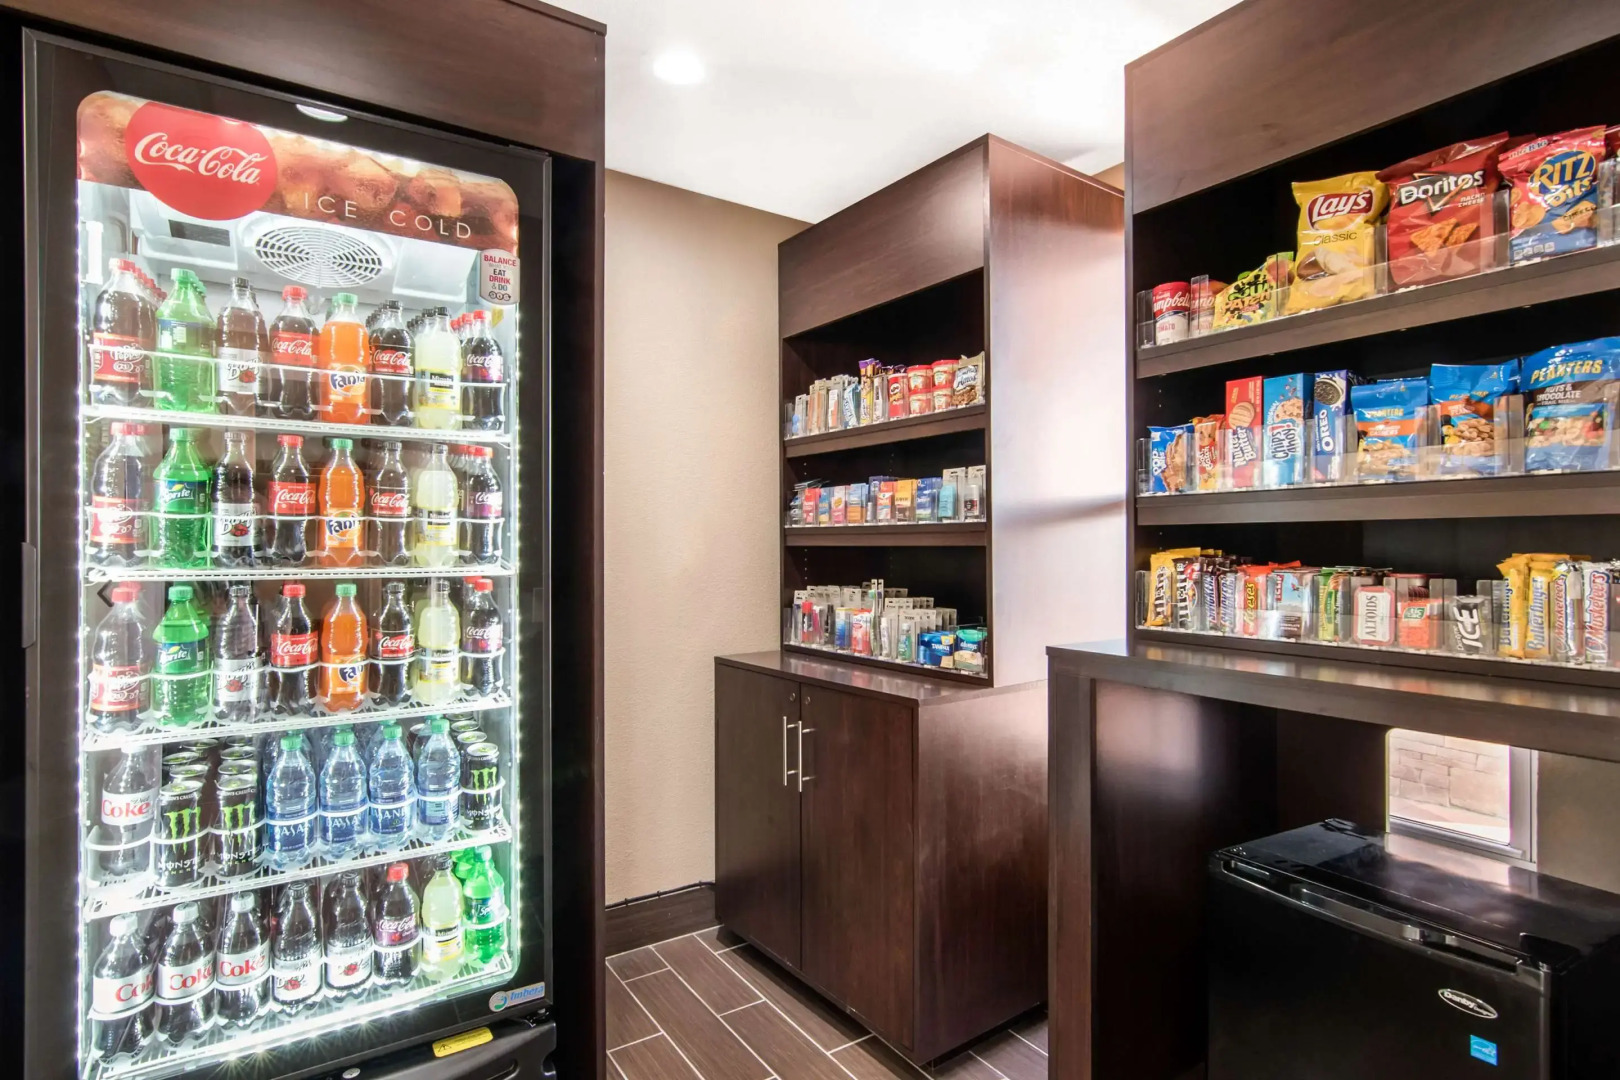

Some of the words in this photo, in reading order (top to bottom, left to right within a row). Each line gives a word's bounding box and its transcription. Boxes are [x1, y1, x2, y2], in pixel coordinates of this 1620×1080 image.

[134, 132, 267, 185] Coca-Cola
[1533, 152, 1590, 190] RITZ
[1401, 171, 1484, 204] Doritos
[304, 192, 357, 218] ICE
[389, 210, 471, 239] COLD
[1312, 189, 1370, 222] Lay's
[1313, 230, 1358, 247] Classic
[483, 254, 517, 267] BALANCE
[493, 268, 507, 276] EAT
[489, 275, 511, 284] DRINK
[498, 283, 508, 291] DO
[1530, 360, 1604, 384] PLANTERS
[1537, 390, 1581, 401] CHOCOLATE
[1238, 427, 1256, 462] Butter
[1319, 410, 1335, 452] OREO
[1271, 431, 1287, 460] Chips
[1365, 595, 1378, 637] ALTOIDS
[1587, 573, 1606, 641] Musketeers
[1453, 607, 1483, 648] ICE
[102, 799, 151, 817] Coke
[169, 964, 214, 992] Coke
[220, 953, 267, 978] Coke
[510, 984, 545, 1000] Imbera
